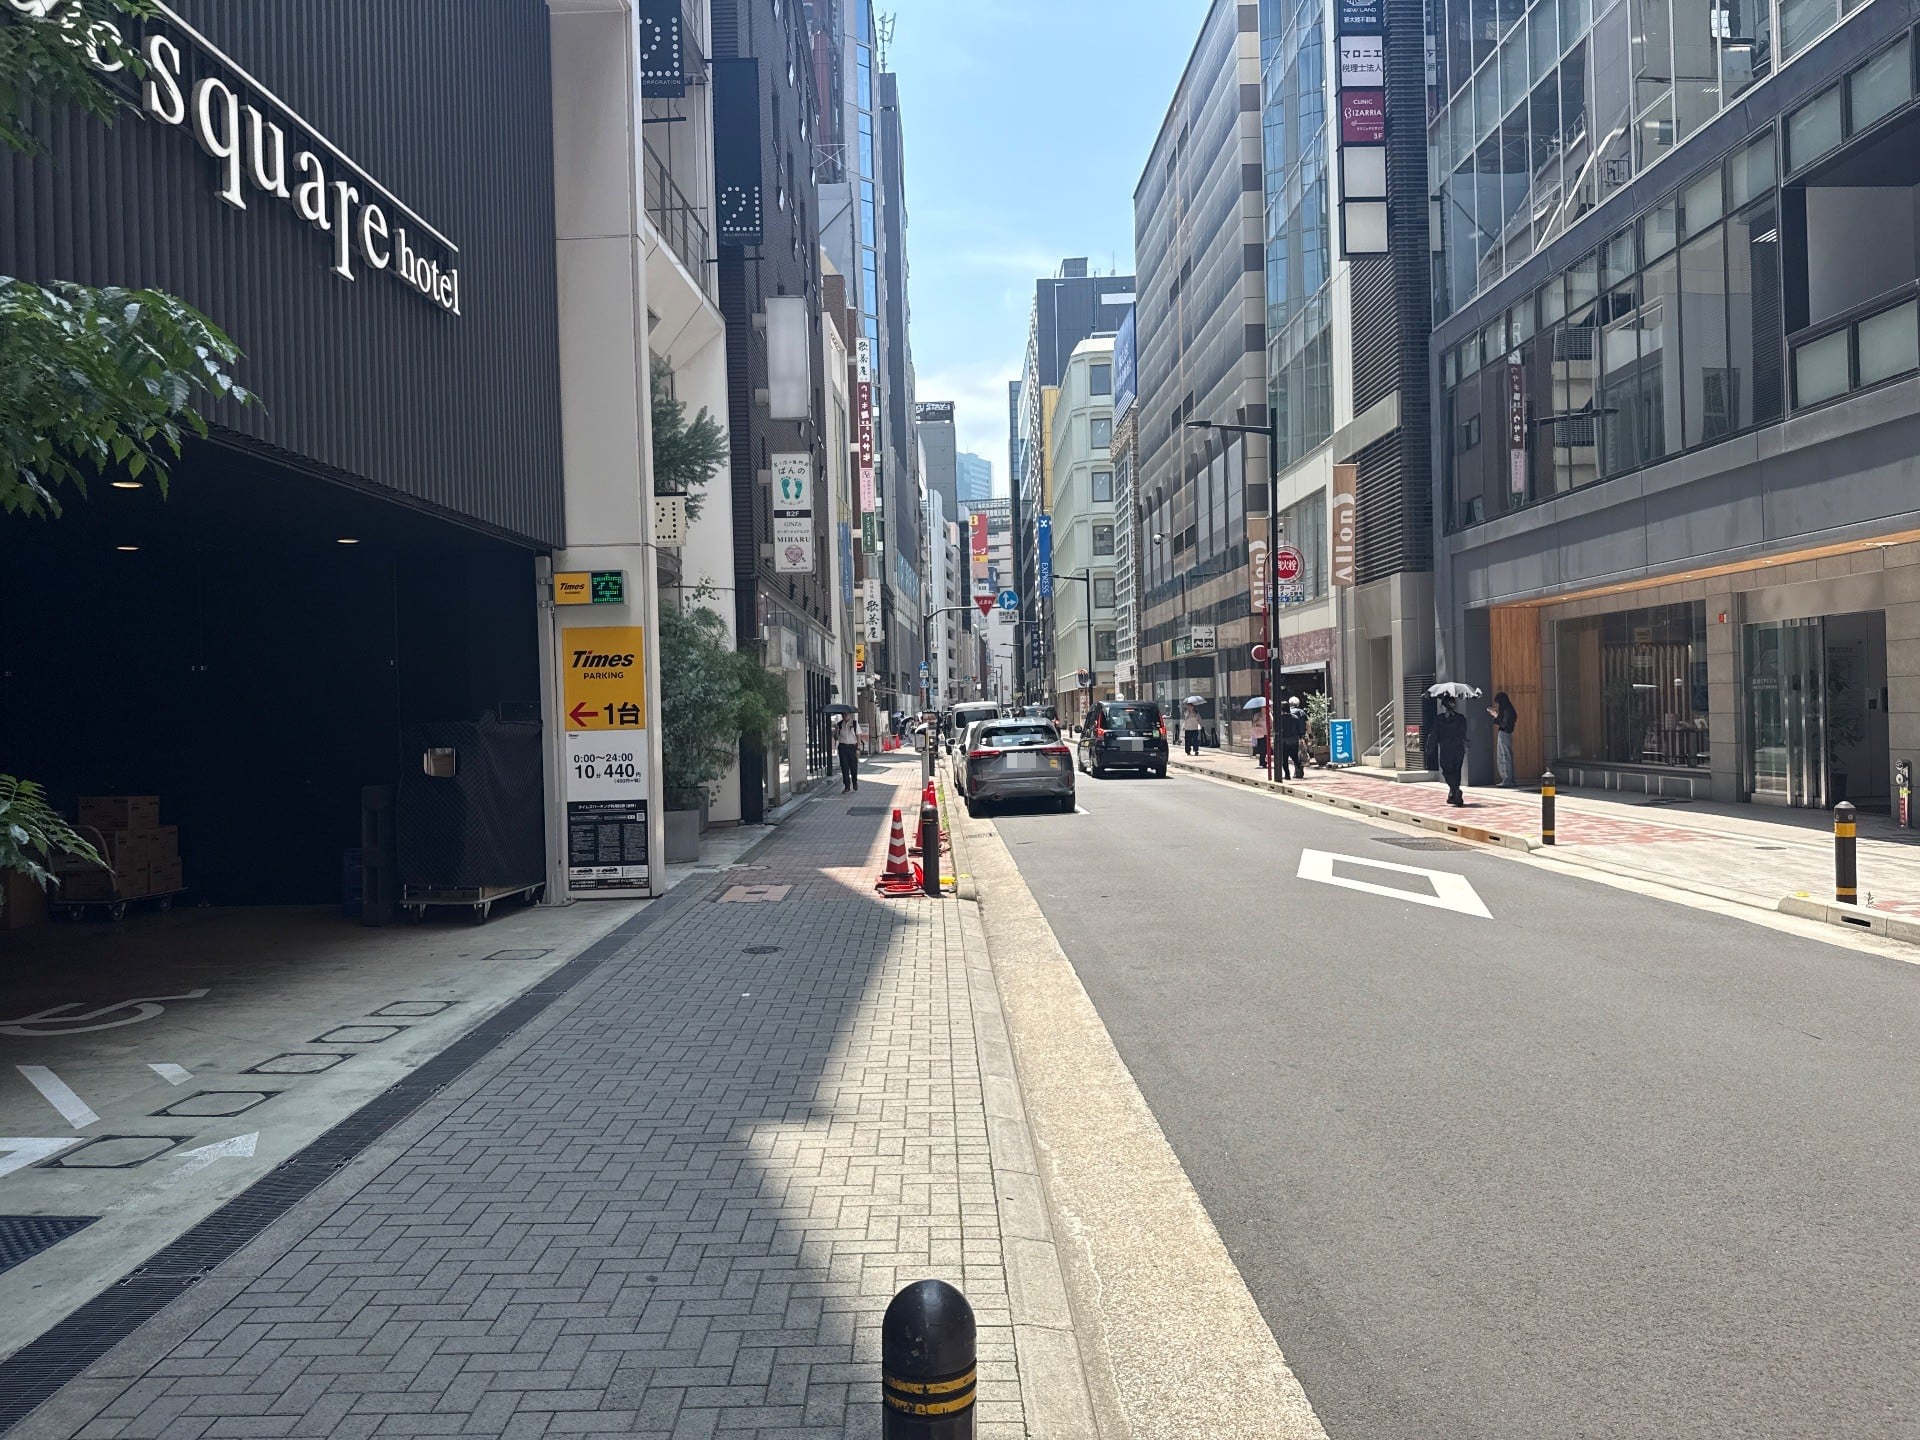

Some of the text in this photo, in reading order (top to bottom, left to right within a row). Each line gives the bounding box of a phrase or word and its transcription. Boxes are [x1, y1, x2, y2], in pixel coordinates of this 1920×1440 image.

[1341, 49, 1383, 58] マロニエ
[1342, 63, 1383, 73] 税理士法人
[1373, 132, 1383, 140] 3F
[142, 34, 390, 282] square
[393, 228, 461, 317] hotel
[721, 186, 761, 232] 21
[1041, 562, 1050, 594] EXPRESS
[560, 582, 585, 591] Times
[572, 650, 635, 668] Times
[583, 672, 624, 680] PARKING
[603, 701, 640, 726] 1台
